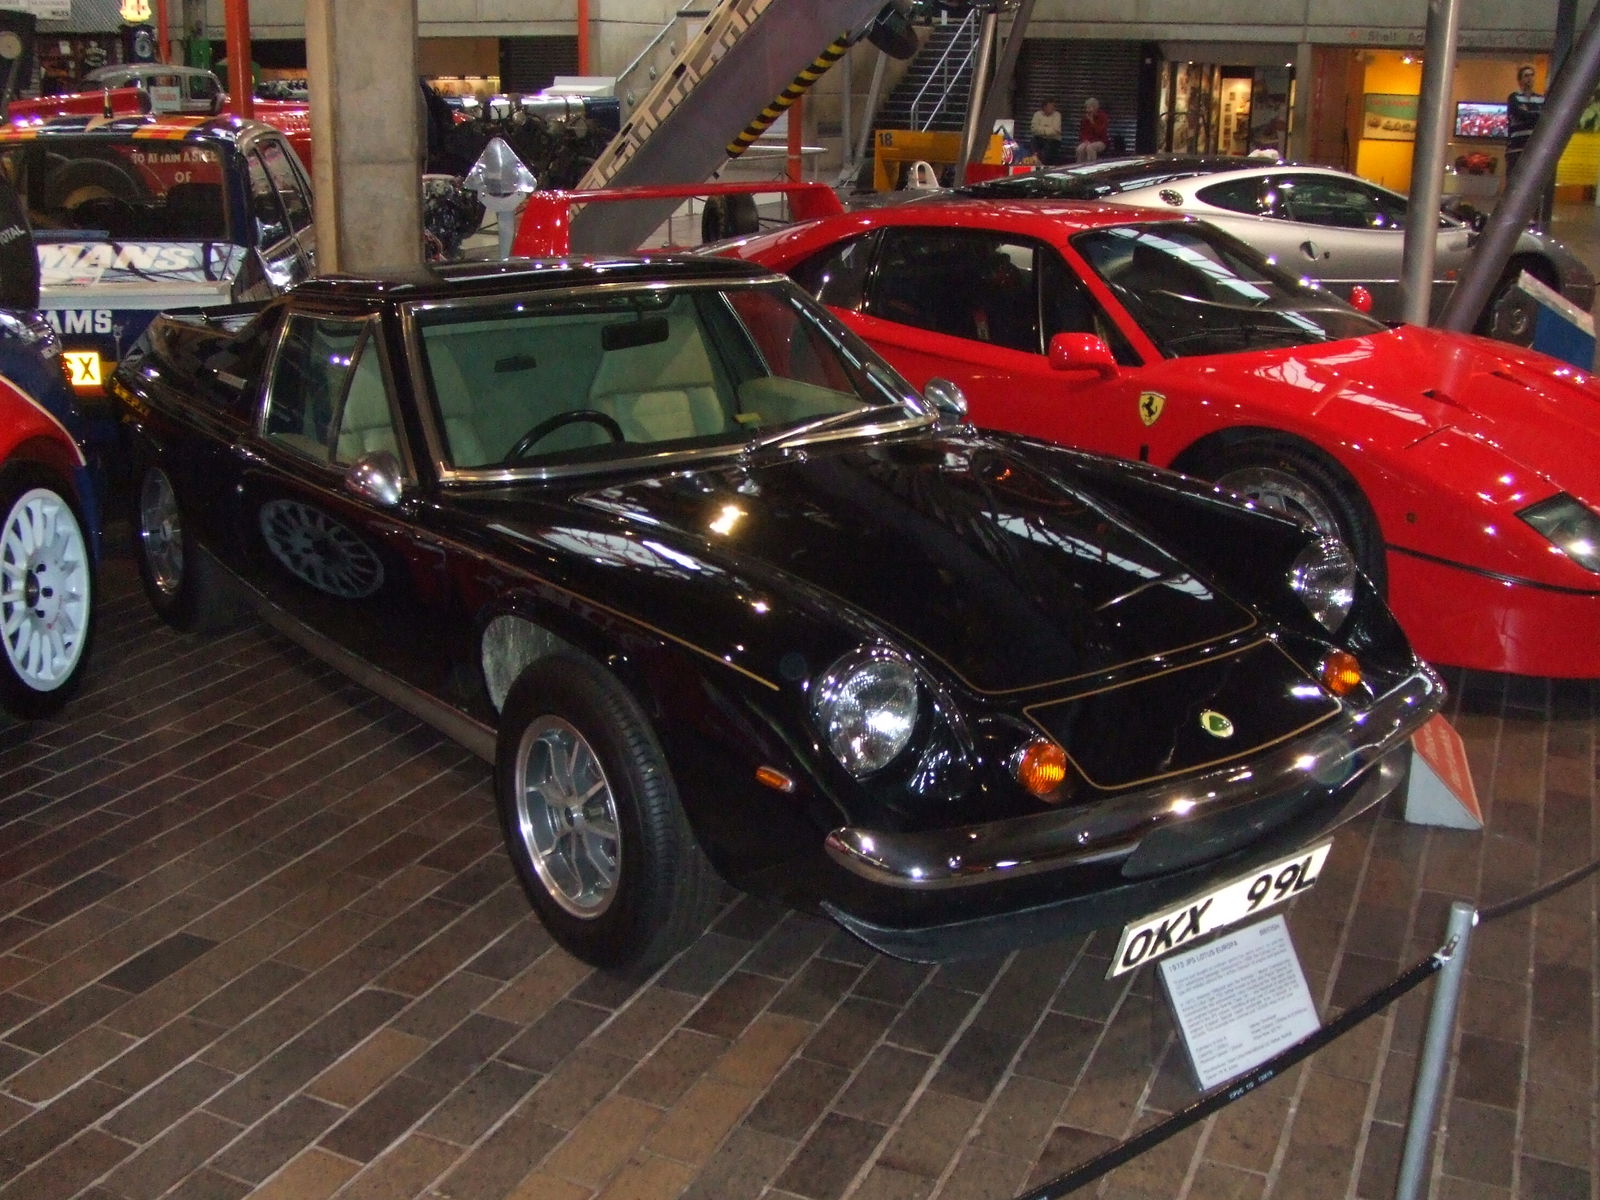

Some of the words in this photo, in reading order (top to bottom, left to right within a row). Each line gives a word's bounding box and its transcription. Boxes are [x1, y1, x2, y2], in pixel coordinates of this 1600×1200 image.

[878, 133, 892, 146] 18
[131, 153, 145, 164] TO
[183, 152, 190, 162] A
[174, 171, 192, 183] OF
[1122, 898, 1214, 968] OKX
[1247, 856, 1316, 912] 99L
[1197, 949, 1216, 961] LOTUS
[1216, 940, 1238, 954] EUROPA
